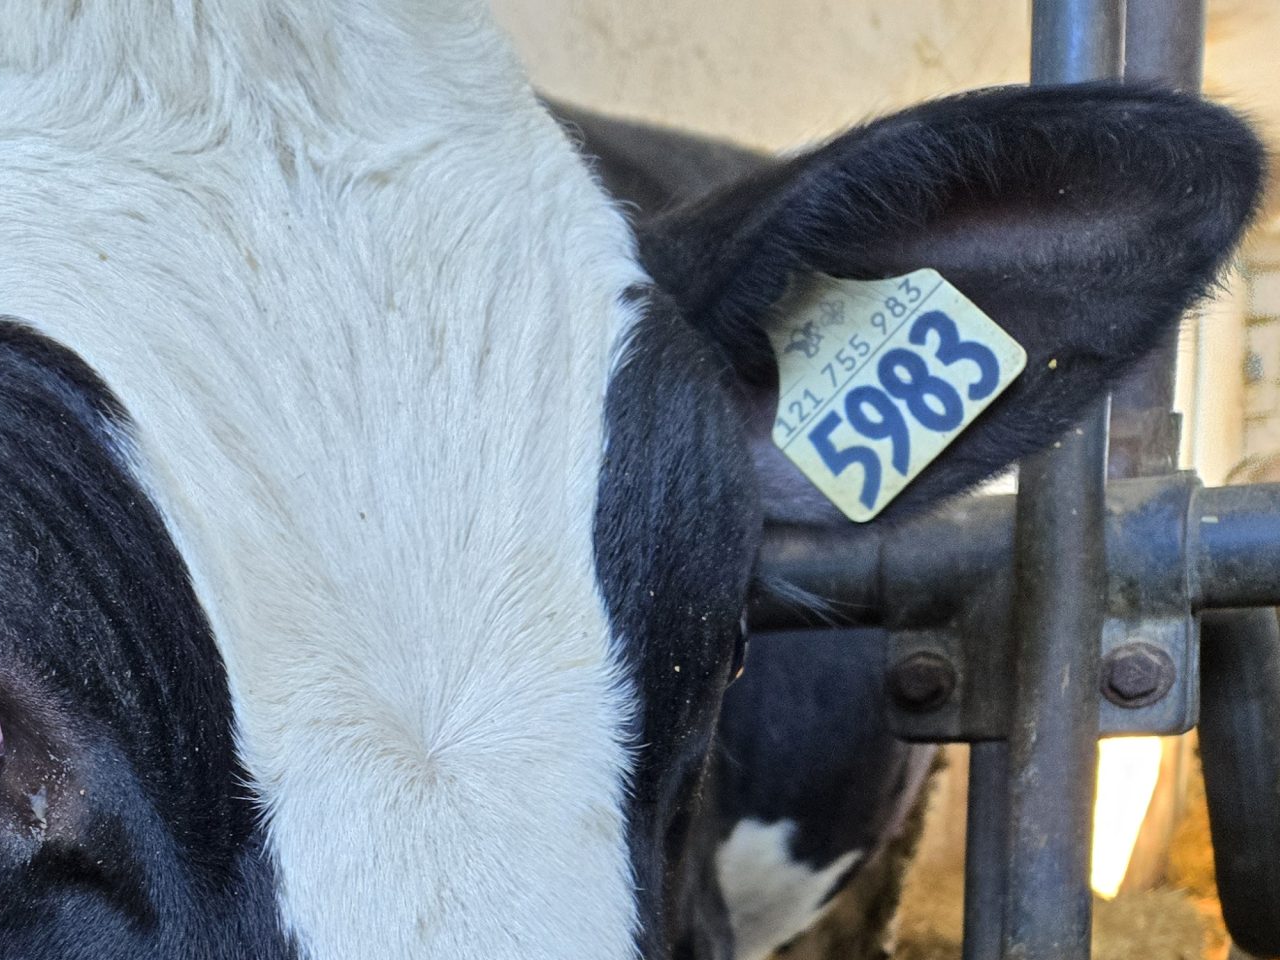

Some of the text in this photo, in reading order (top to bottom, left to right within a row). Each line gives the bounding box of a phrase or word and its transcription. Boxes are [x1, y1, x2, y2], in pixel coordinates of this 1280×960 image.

[776, 277, 921, 438] 121 755 983
[808, 310, 1000, 511] 5983
